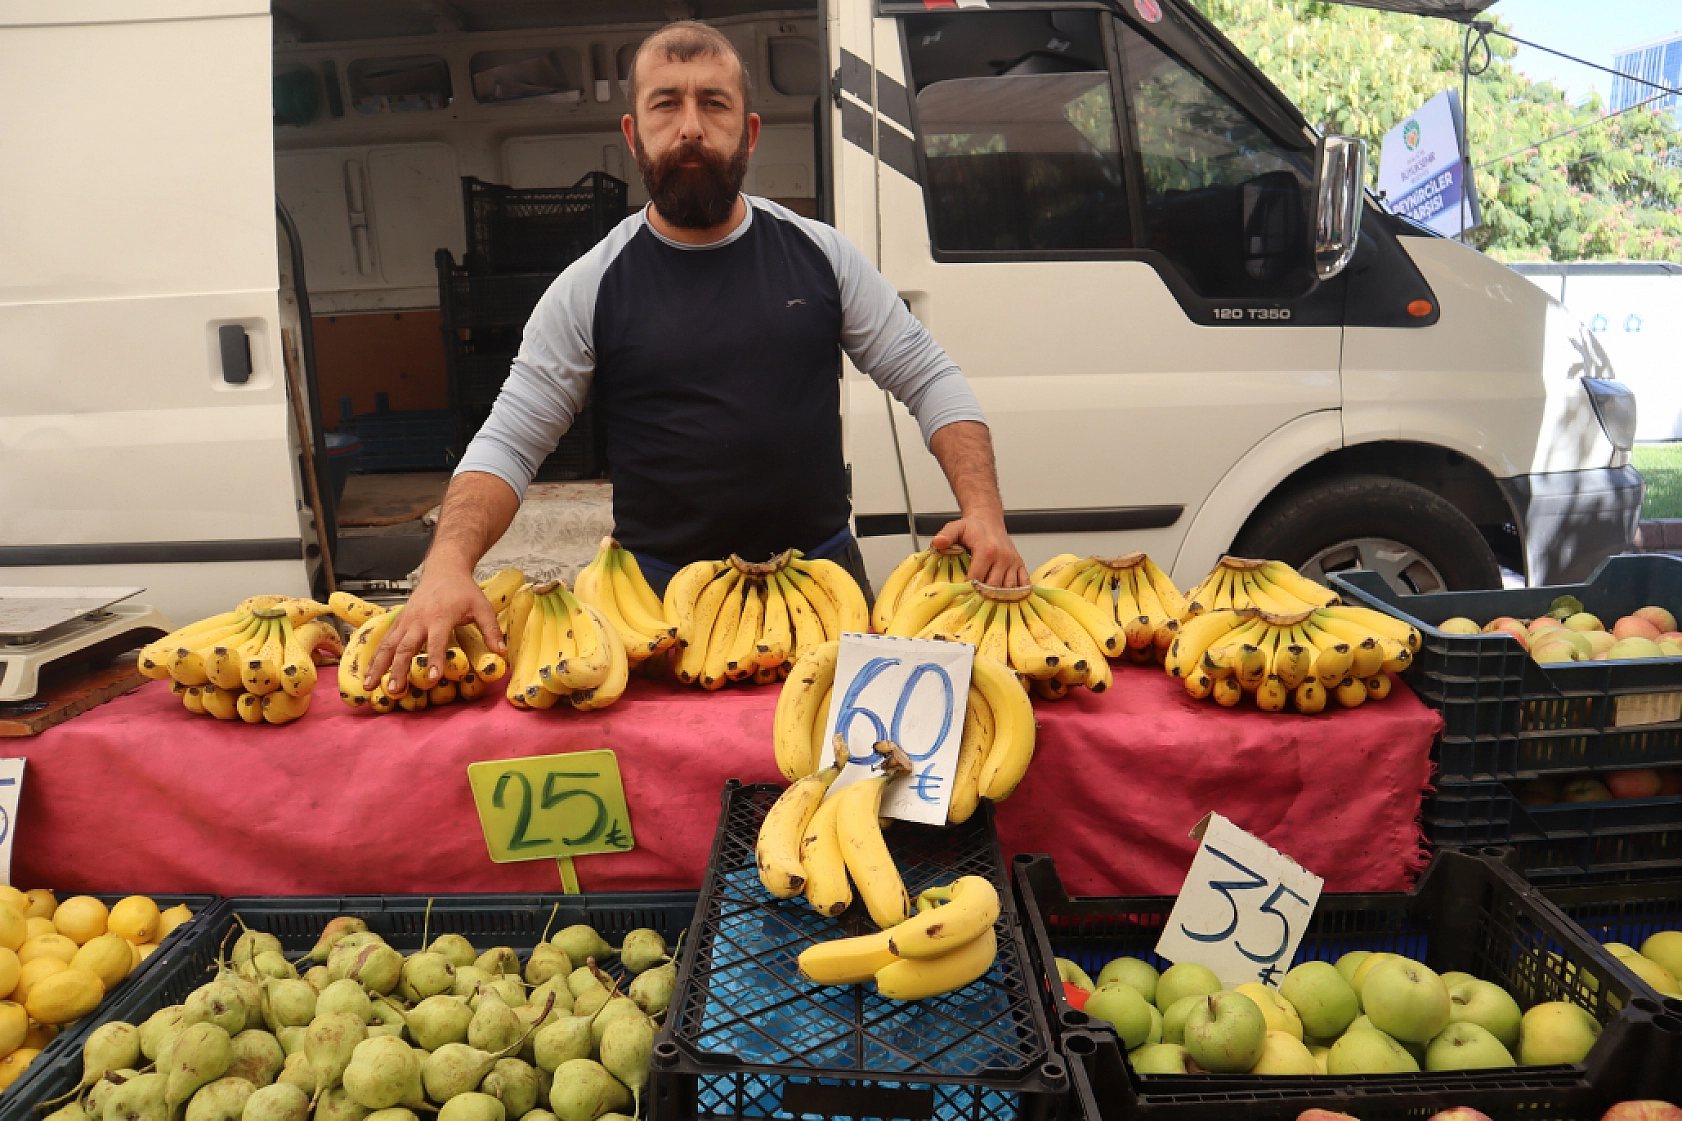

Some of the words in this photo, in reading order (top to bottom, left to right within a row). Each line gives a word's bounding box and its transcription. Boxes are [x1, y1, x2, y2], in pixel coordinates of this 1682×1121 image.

[1213, 308, 1243, 319] 120
[1247, 308, 1291, 319] T350
[835, 657, 954, 765] 60
[492, 770, 608, 850] 25
[1180, 844, 1310, 964] 35
